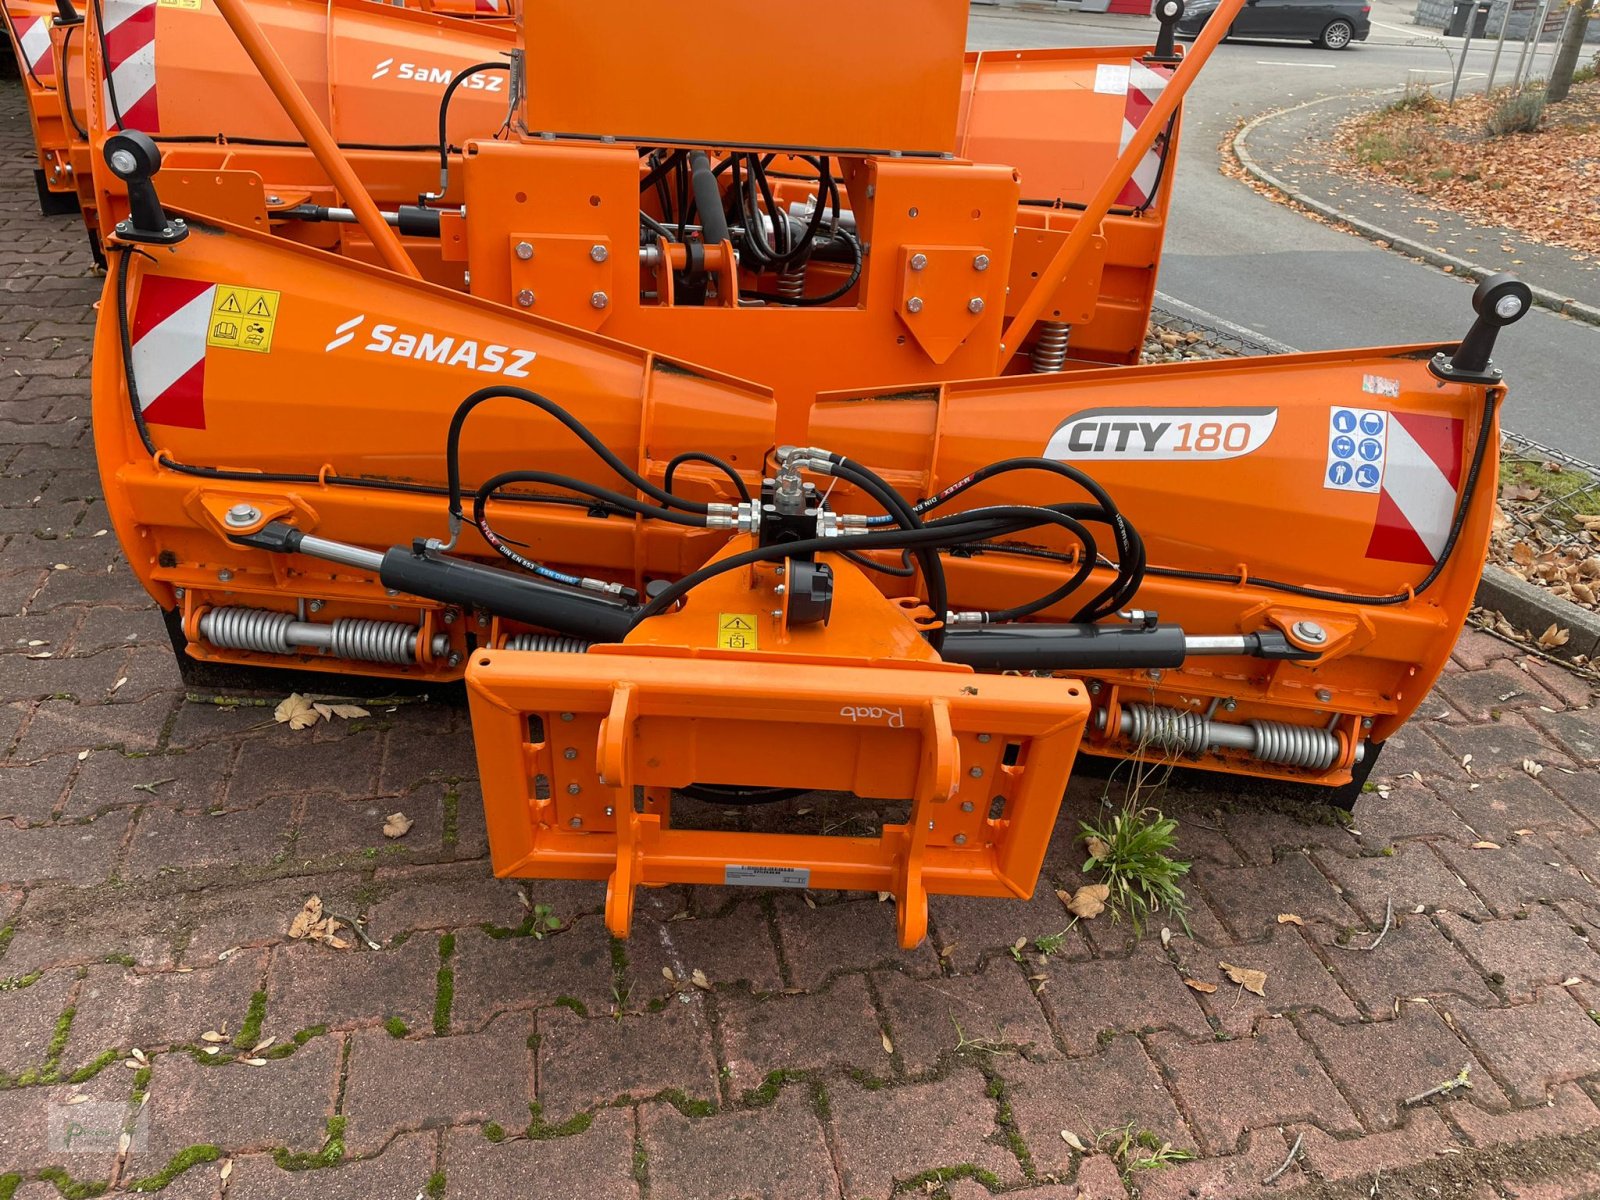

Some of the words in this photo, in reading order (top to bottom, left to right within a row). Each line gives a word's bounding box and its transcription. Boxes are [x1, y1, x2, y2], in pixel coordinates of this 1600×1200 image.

[365, 323, 536, 378] SaMASZ
[1068, 422, 1171, 452] CITY
[1173, 422, 1251, 452] 180
[924, 496, 938, 507] DIN
[499, 545, 513, 557] DIN
[511, 554, 522, 564] EN
[840, 706, 905, 729] Raab
